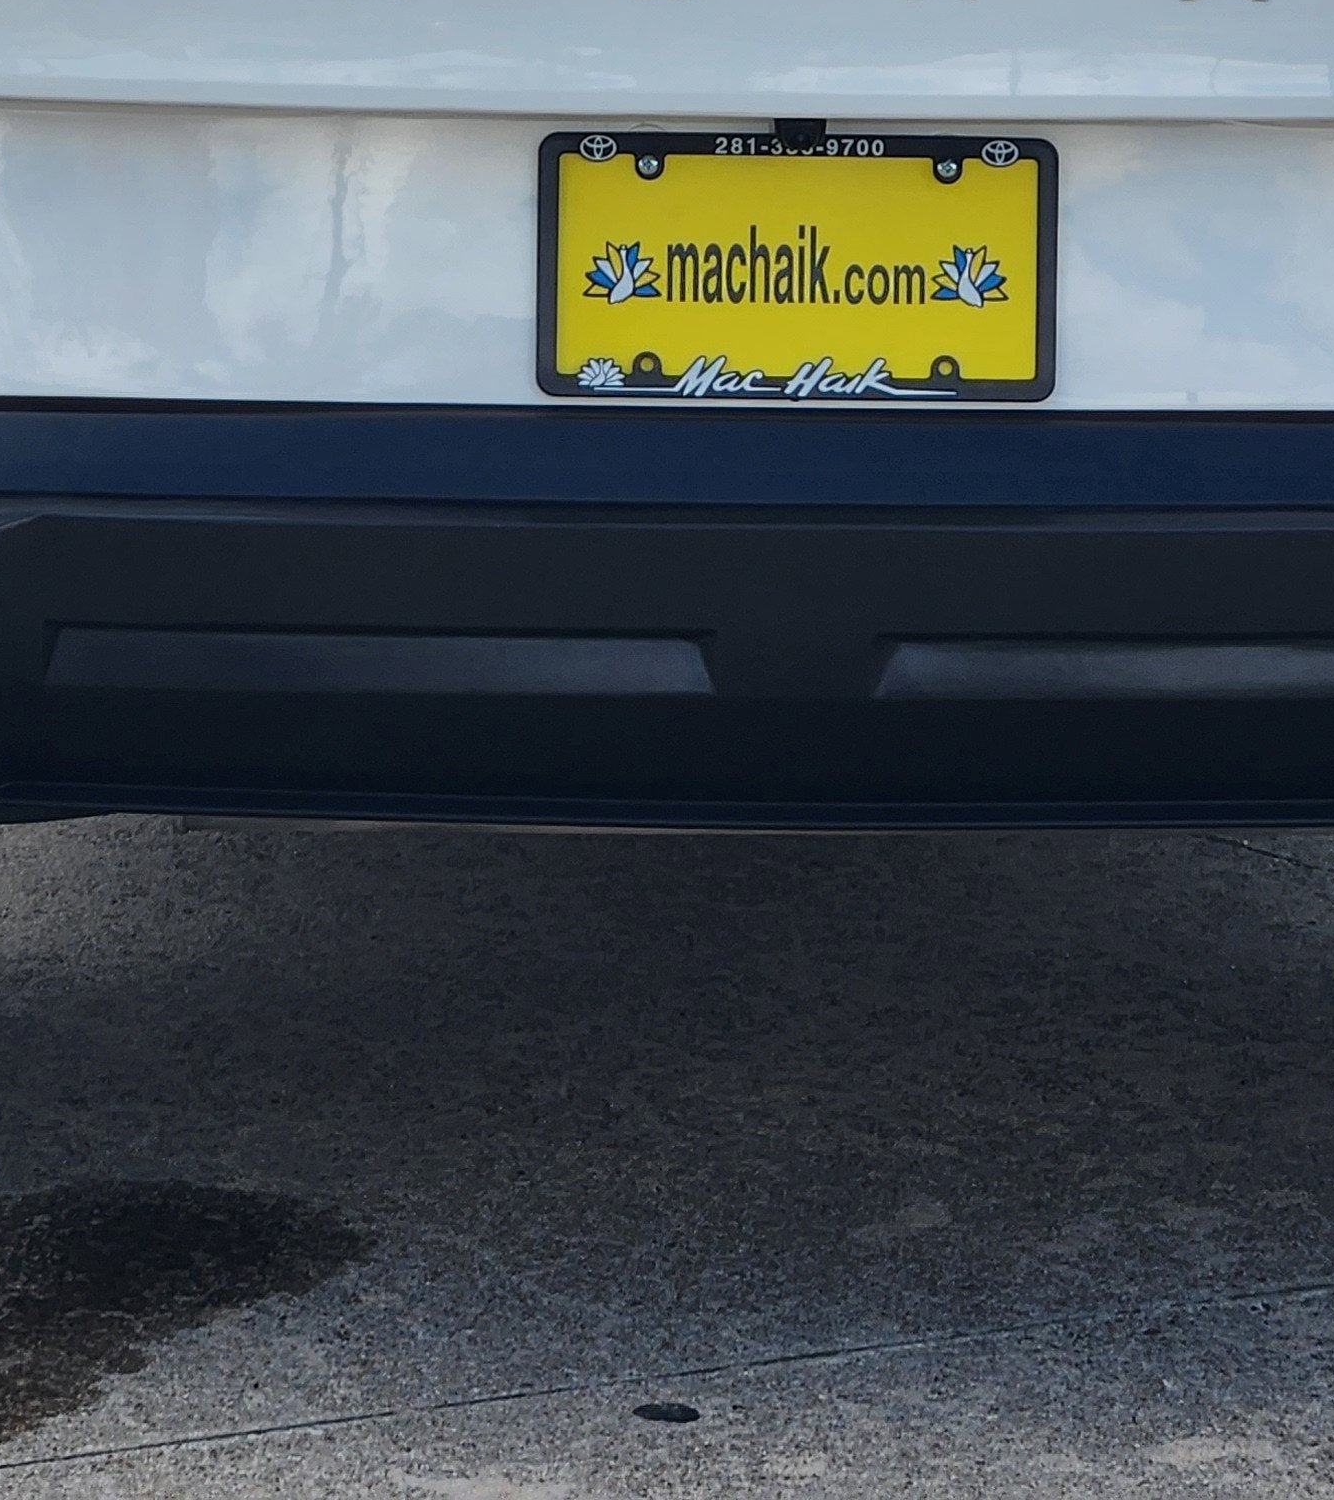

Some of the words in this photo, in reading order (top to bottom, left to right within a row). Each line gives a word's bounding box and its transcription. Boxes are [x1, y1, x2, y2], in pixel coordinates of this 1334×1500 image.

[667, 224, 926, 305] machaik.com
[675, 355, 782, 397] Mac
[784, 356, 957, 397] Haik
